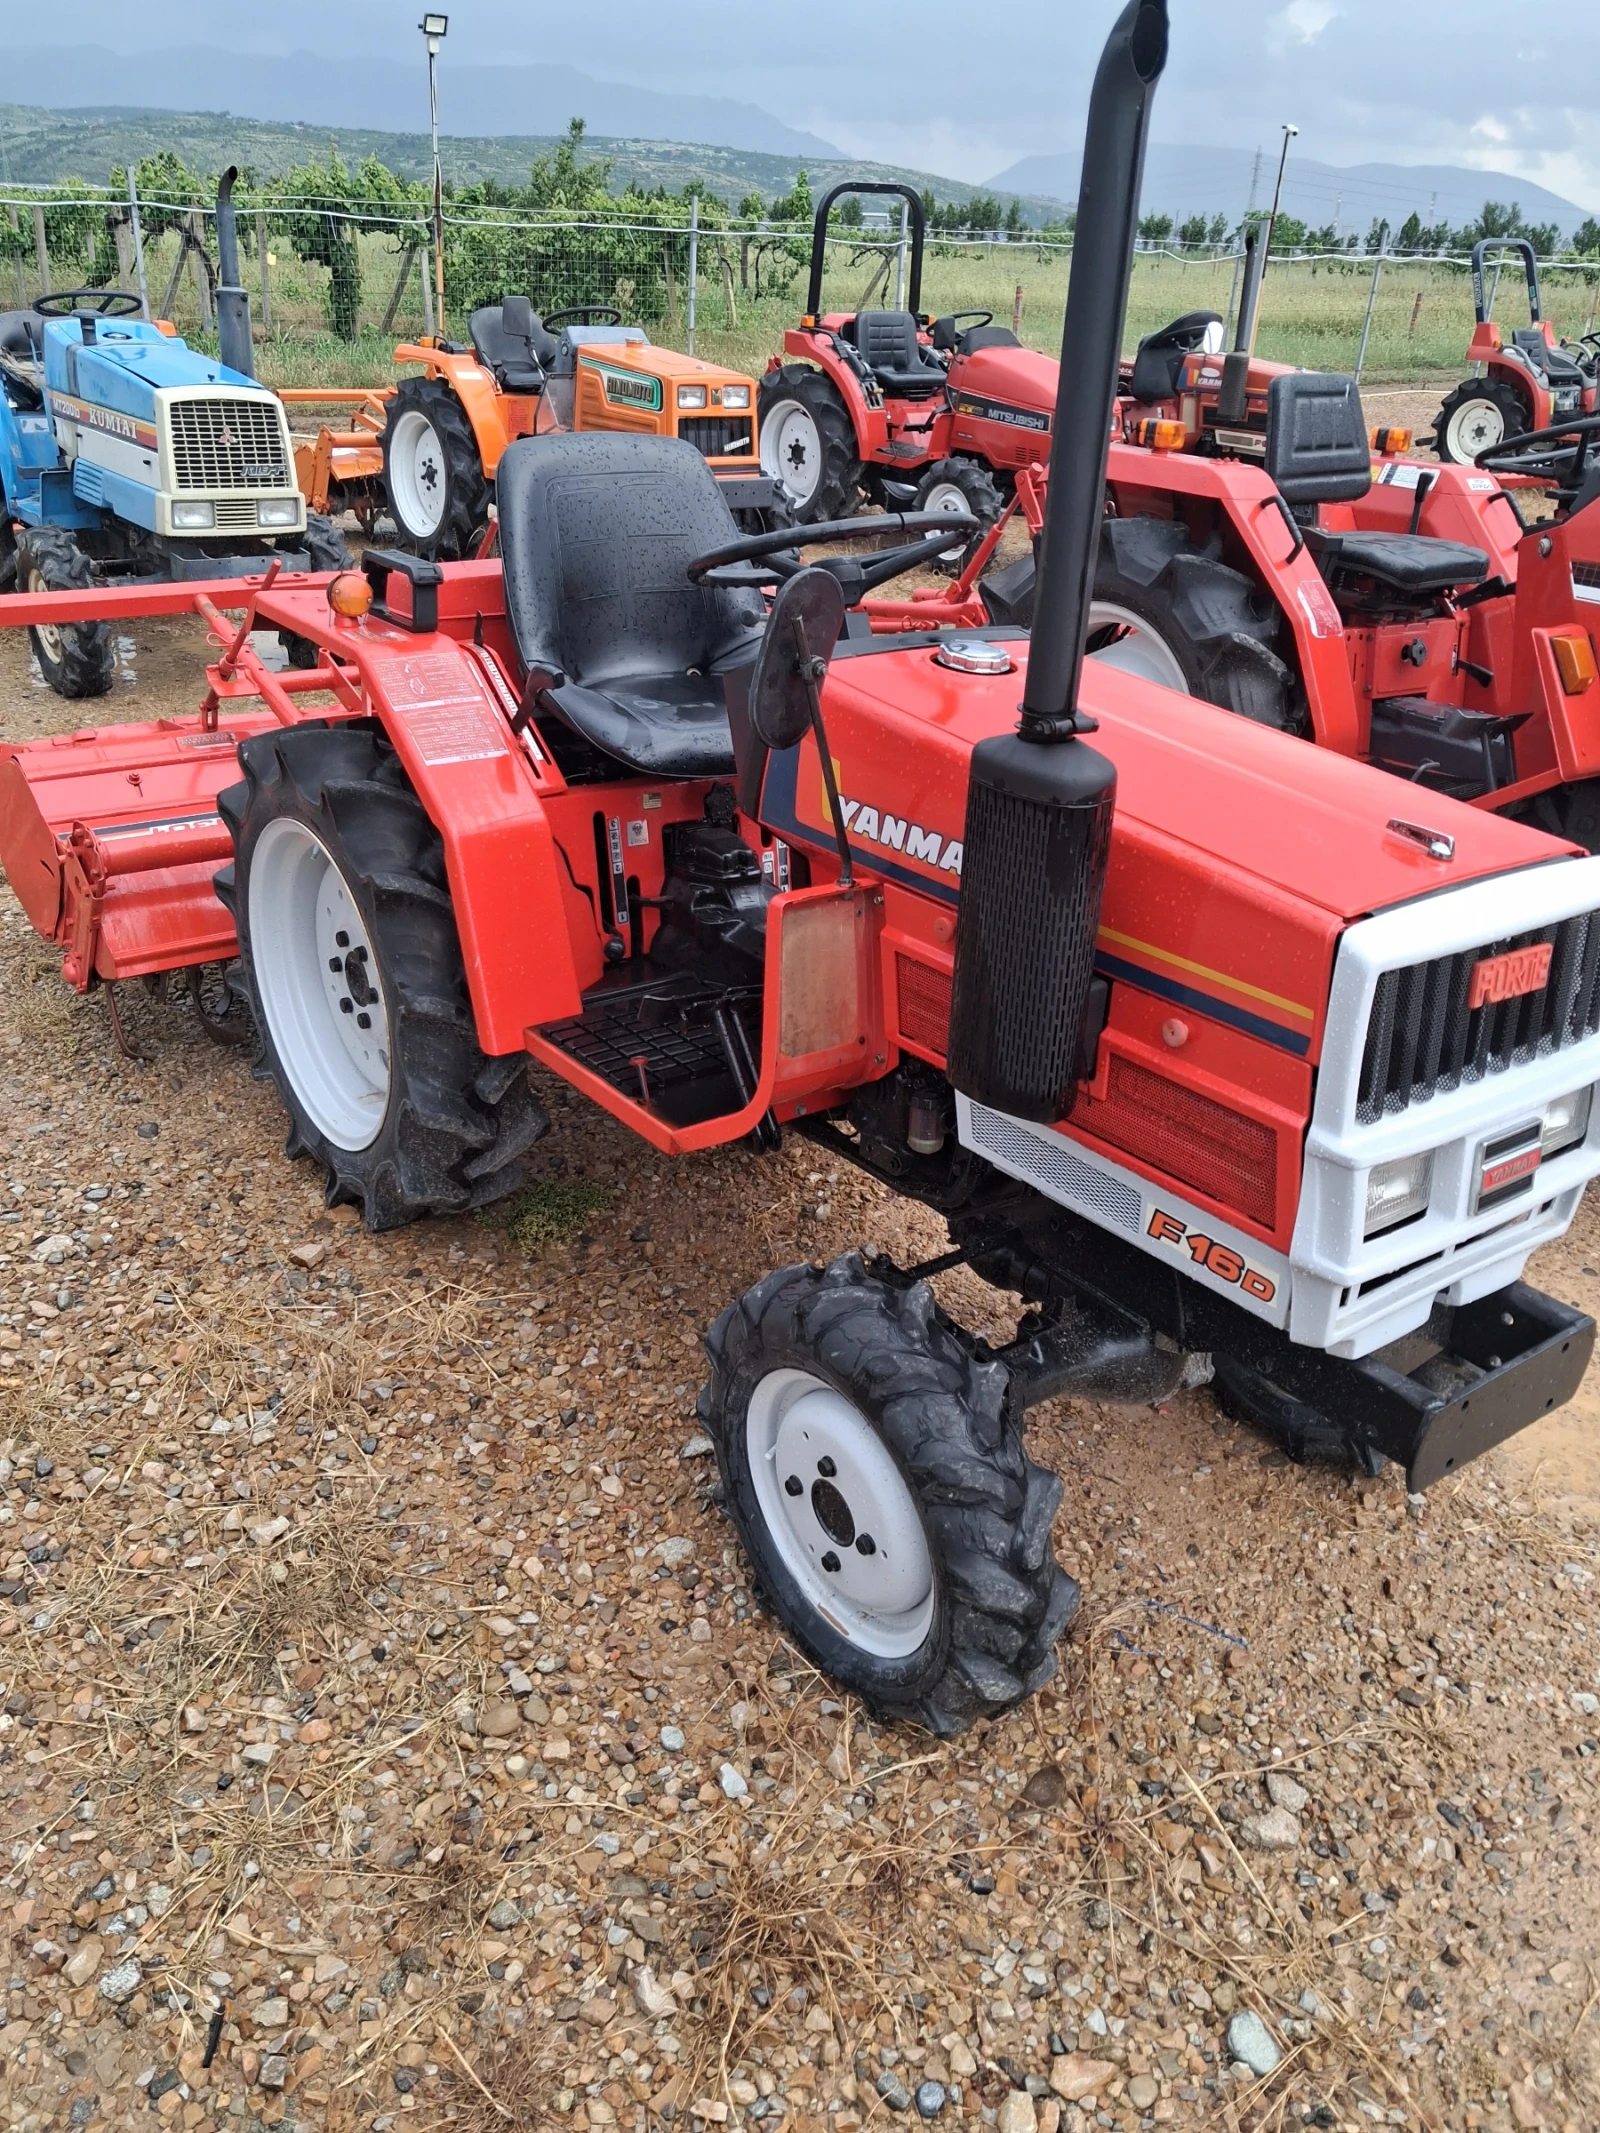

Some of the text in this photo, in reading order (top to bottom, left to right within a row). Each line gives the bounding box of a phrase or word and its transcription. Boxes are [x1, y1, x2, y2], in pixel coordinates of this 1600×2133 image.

[607, 376, 653, 402] HINOMOTO
[89, 408, 137, 439] KUMIAI
[988, 409, 1044, 429] MITSUBISHI
[838, 793, 963, 876] YANMA
[1469, 943, 1553, 1010] FORTE
[1490, 1155, 1537, 1184] YANMAR
[1146, 1208, 1276, 1303] F16D
